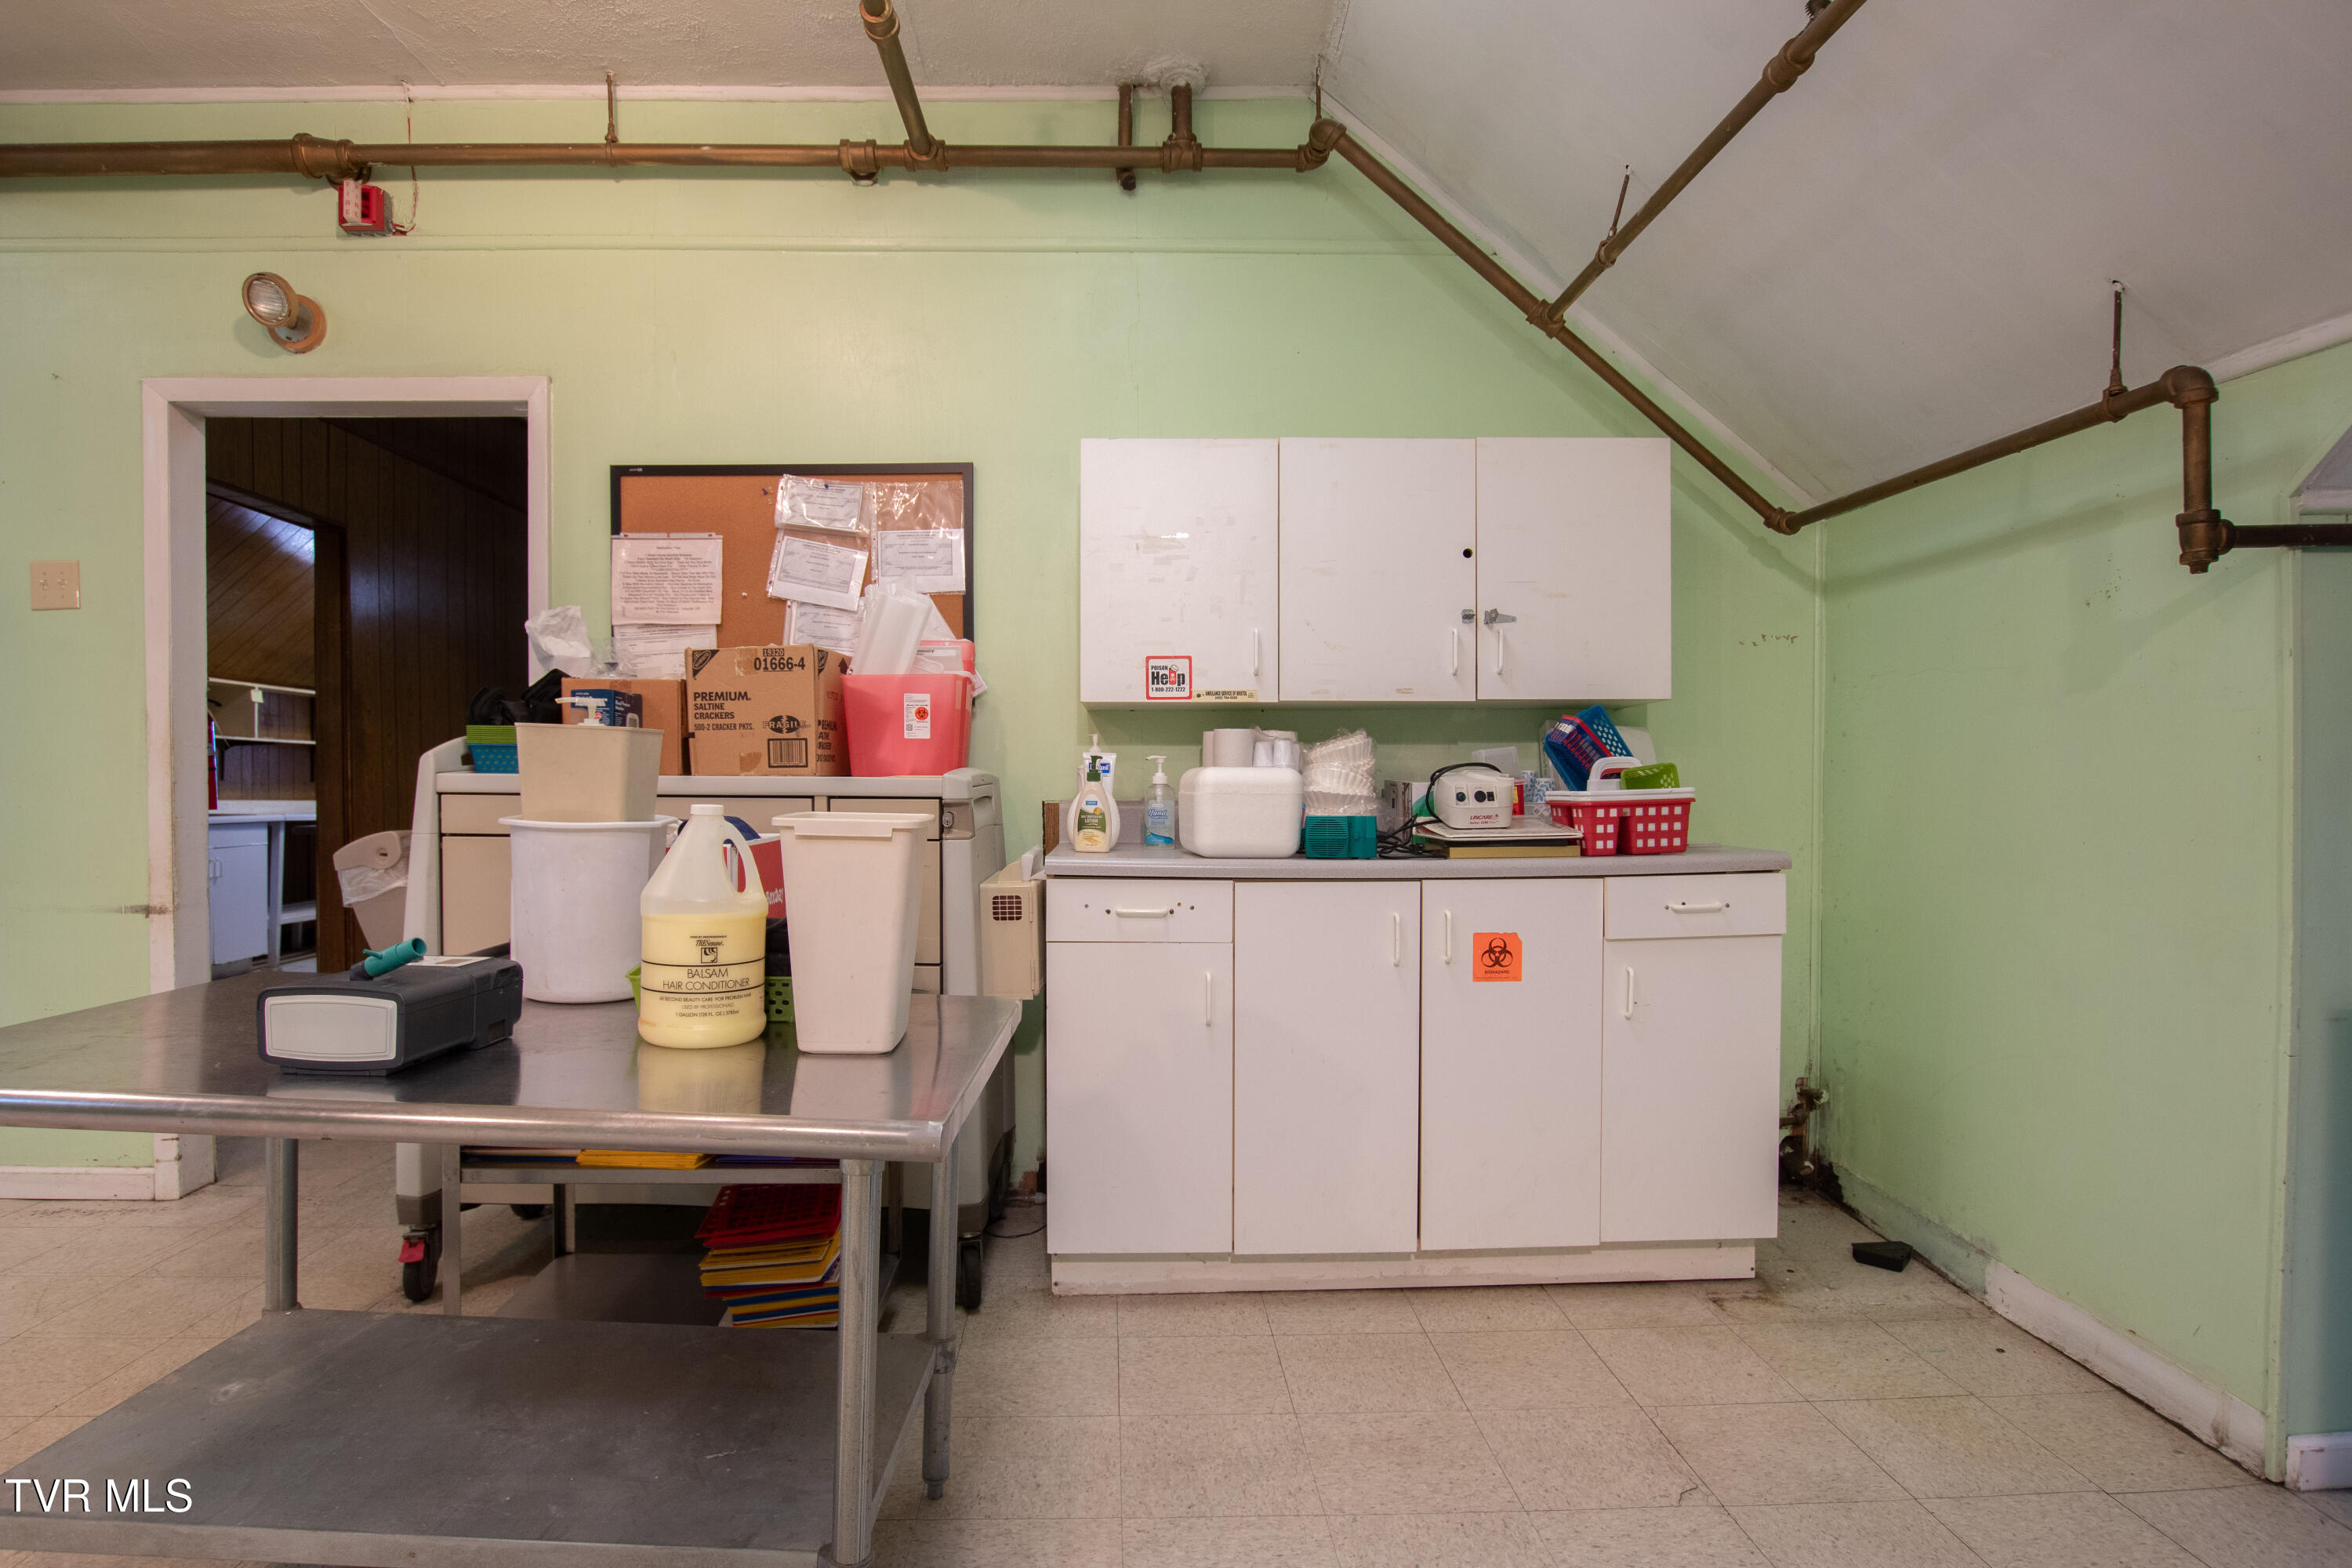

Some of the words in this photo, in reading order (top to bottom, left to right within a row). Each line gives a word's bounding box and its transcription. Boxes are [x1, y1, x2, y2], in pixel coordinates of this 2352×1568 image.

[754, 657, 805, 670] 01666-4
[687, 968, 728, 978] BALSAM
[662, 980, 683, 989] HAIR
[686, 978, 750, 990] CONDITIONER
